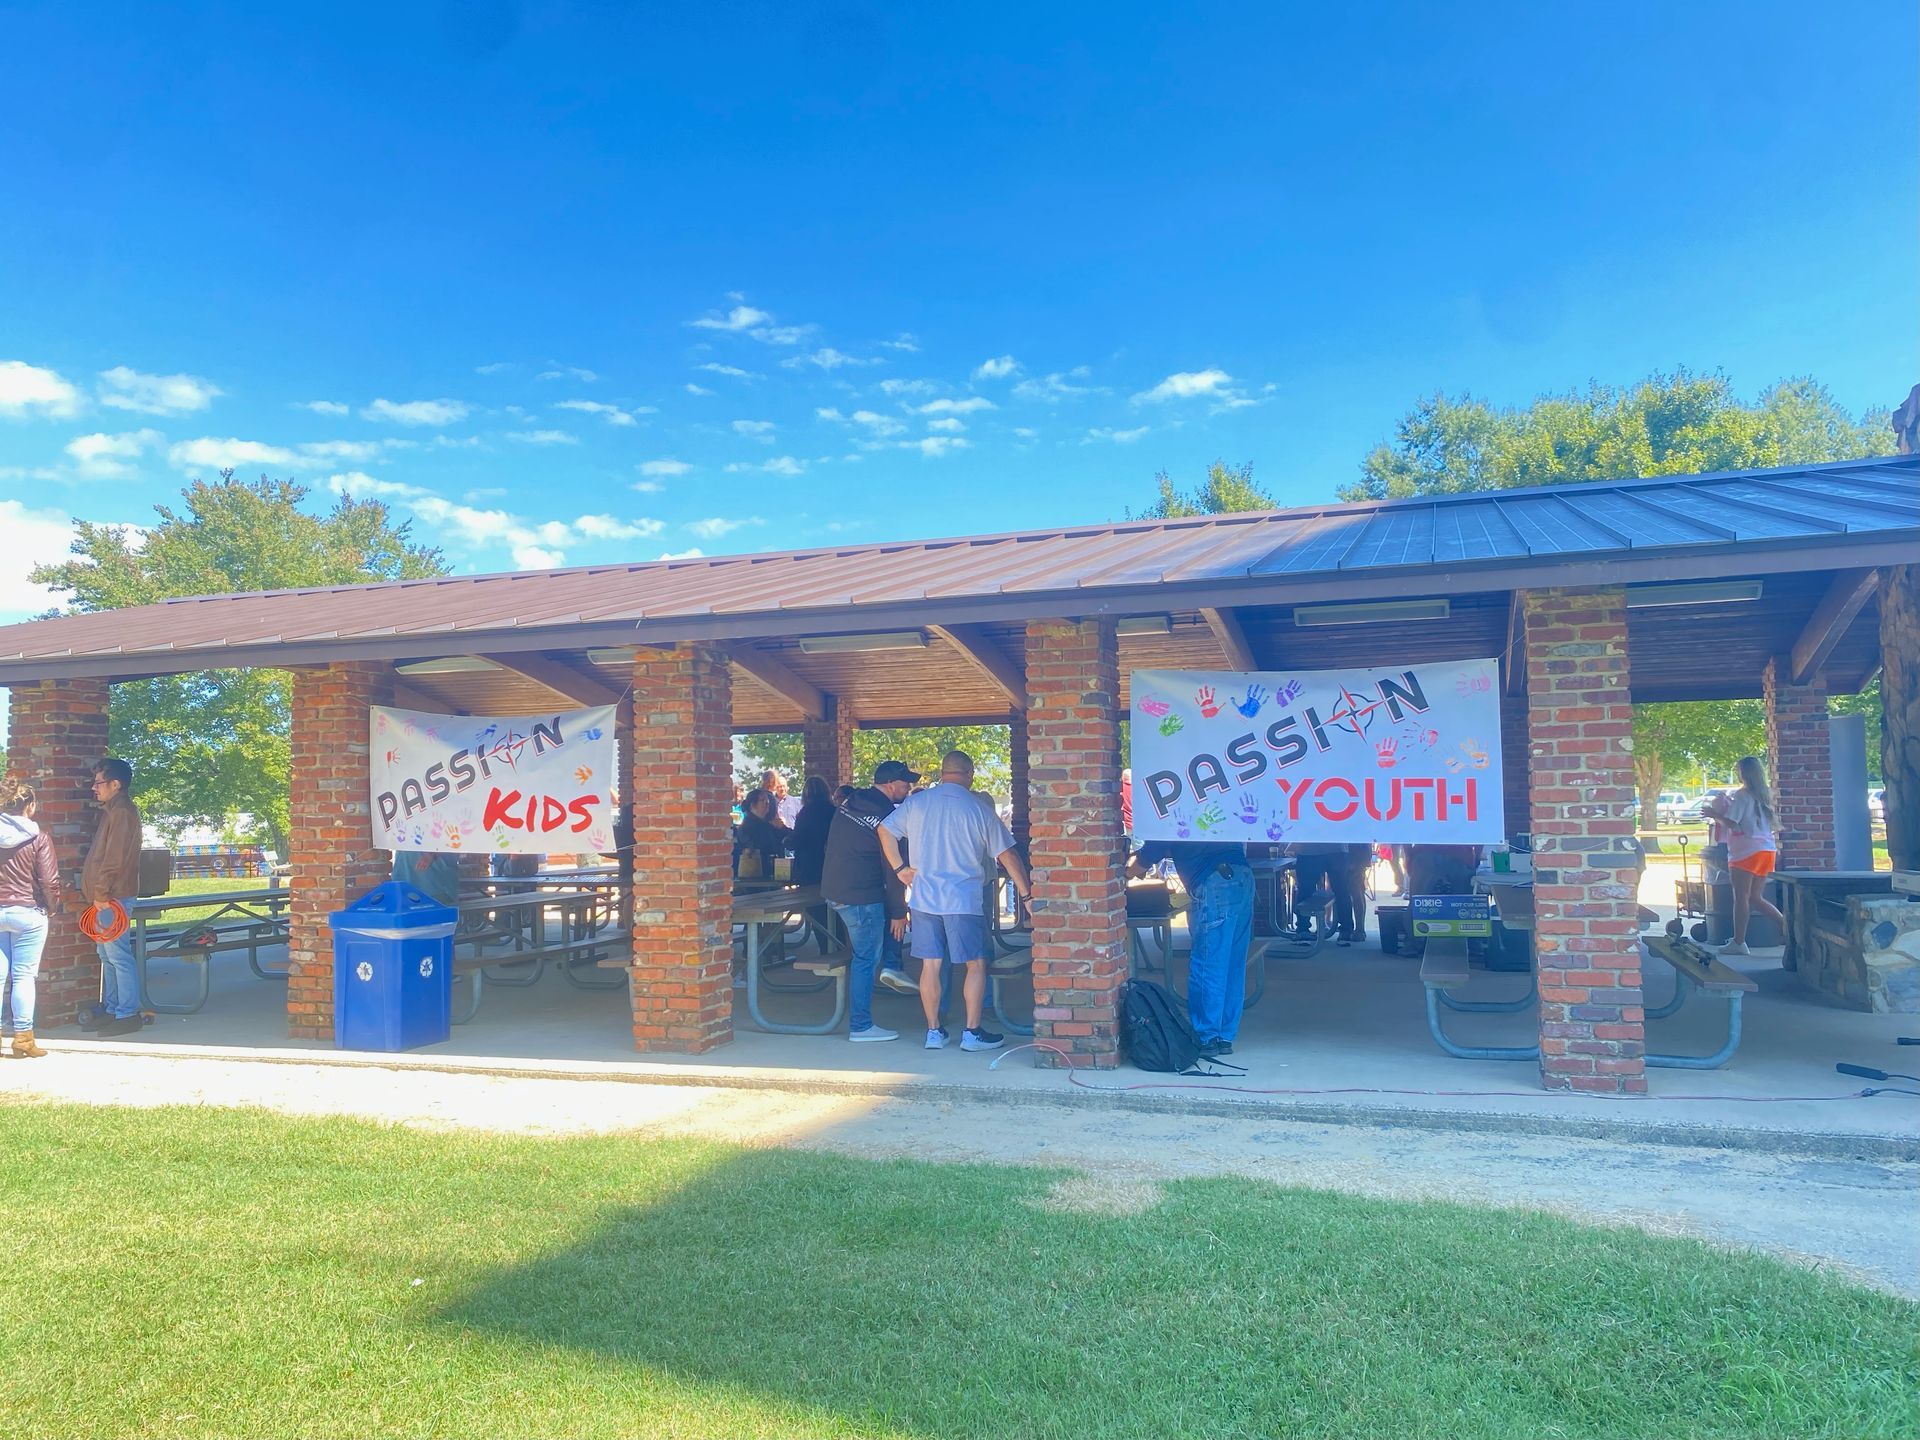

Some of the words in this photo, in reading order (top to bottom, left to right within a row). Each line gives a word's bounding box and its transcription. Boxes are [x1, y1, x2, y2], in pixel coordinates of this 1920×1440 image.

[377, 716, 564, 831] PASSION
[1143, 670, 1430, 819] PASSION
[483, 787, 600, 833] KIDS
[1275, 777, 1478, 822] YOUTH
